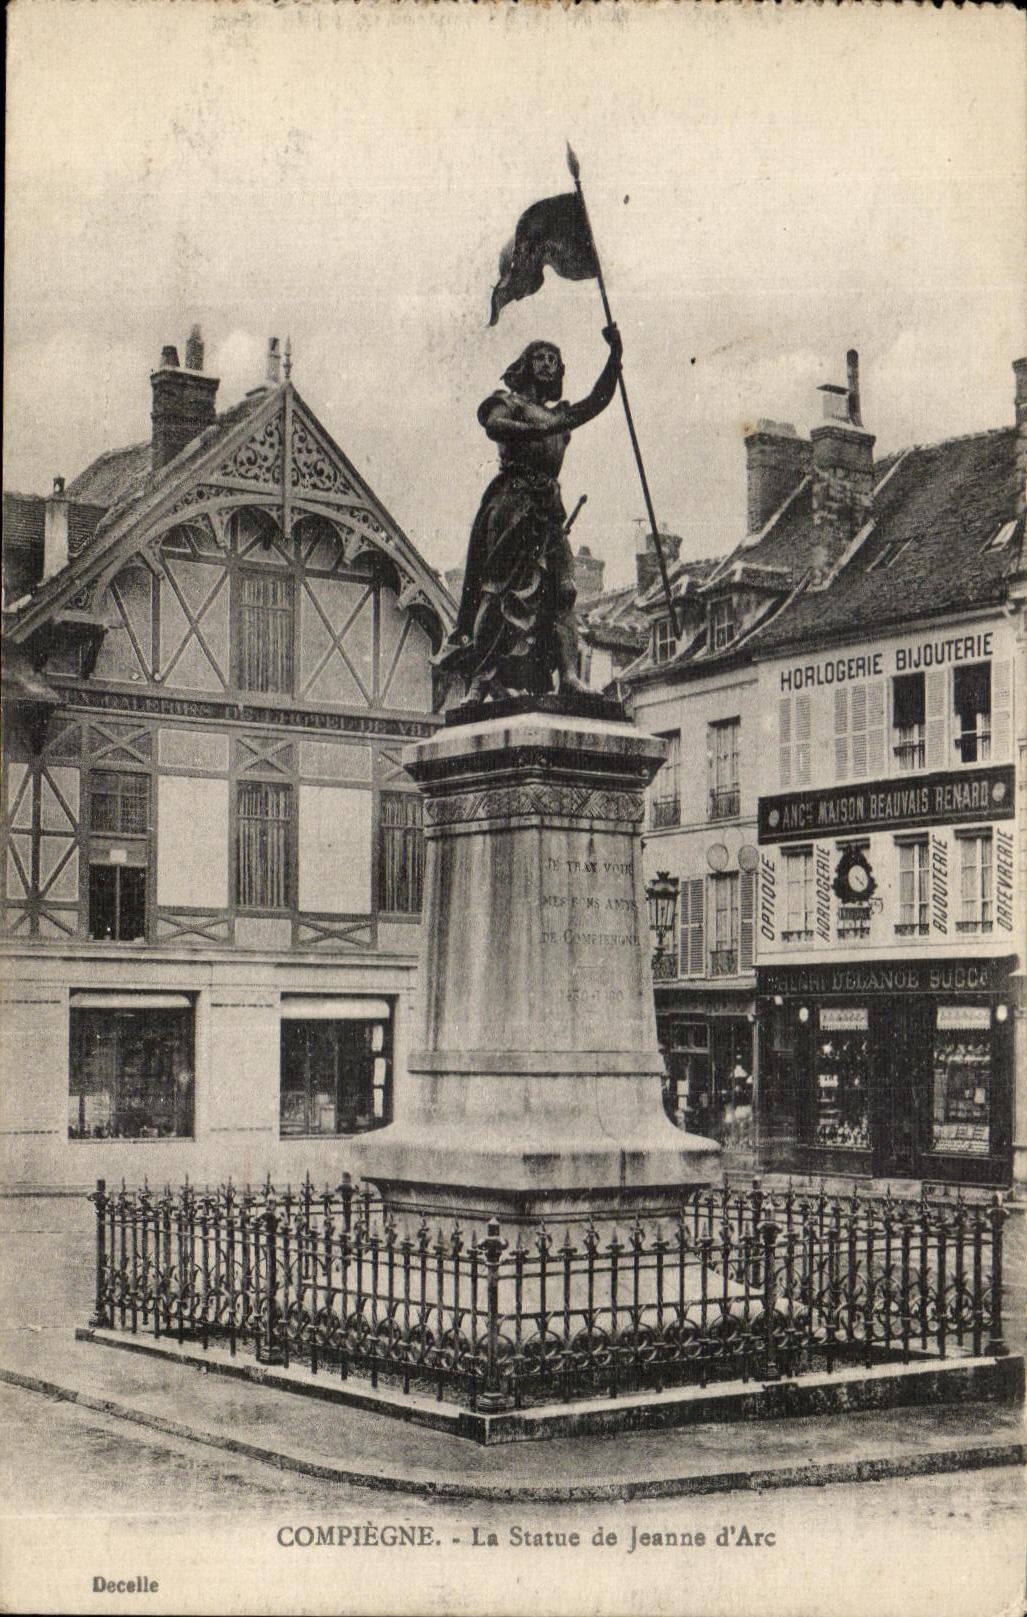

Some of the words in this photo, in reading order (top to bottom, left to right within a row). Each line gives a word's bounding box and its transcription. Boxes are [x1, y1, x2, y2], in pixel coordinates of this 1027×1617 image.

[780, 653, 883, 691] HORLOGERIE
[895, 632, 993, 671] BIJOUTERIE
[818, 796, 865, 825] MAISON
[870, 787, 929, 820] BEAUVAIS
[935, 780, 989, 811] RENARD
[761, 854, 776, 941] OPTIQUE
[816, 844, 831, 942] HORLOGERIE
[932, 834, 948, 935] BIJOUTERIE
[997, 828, 1014, 932] ORFEVRERIE
